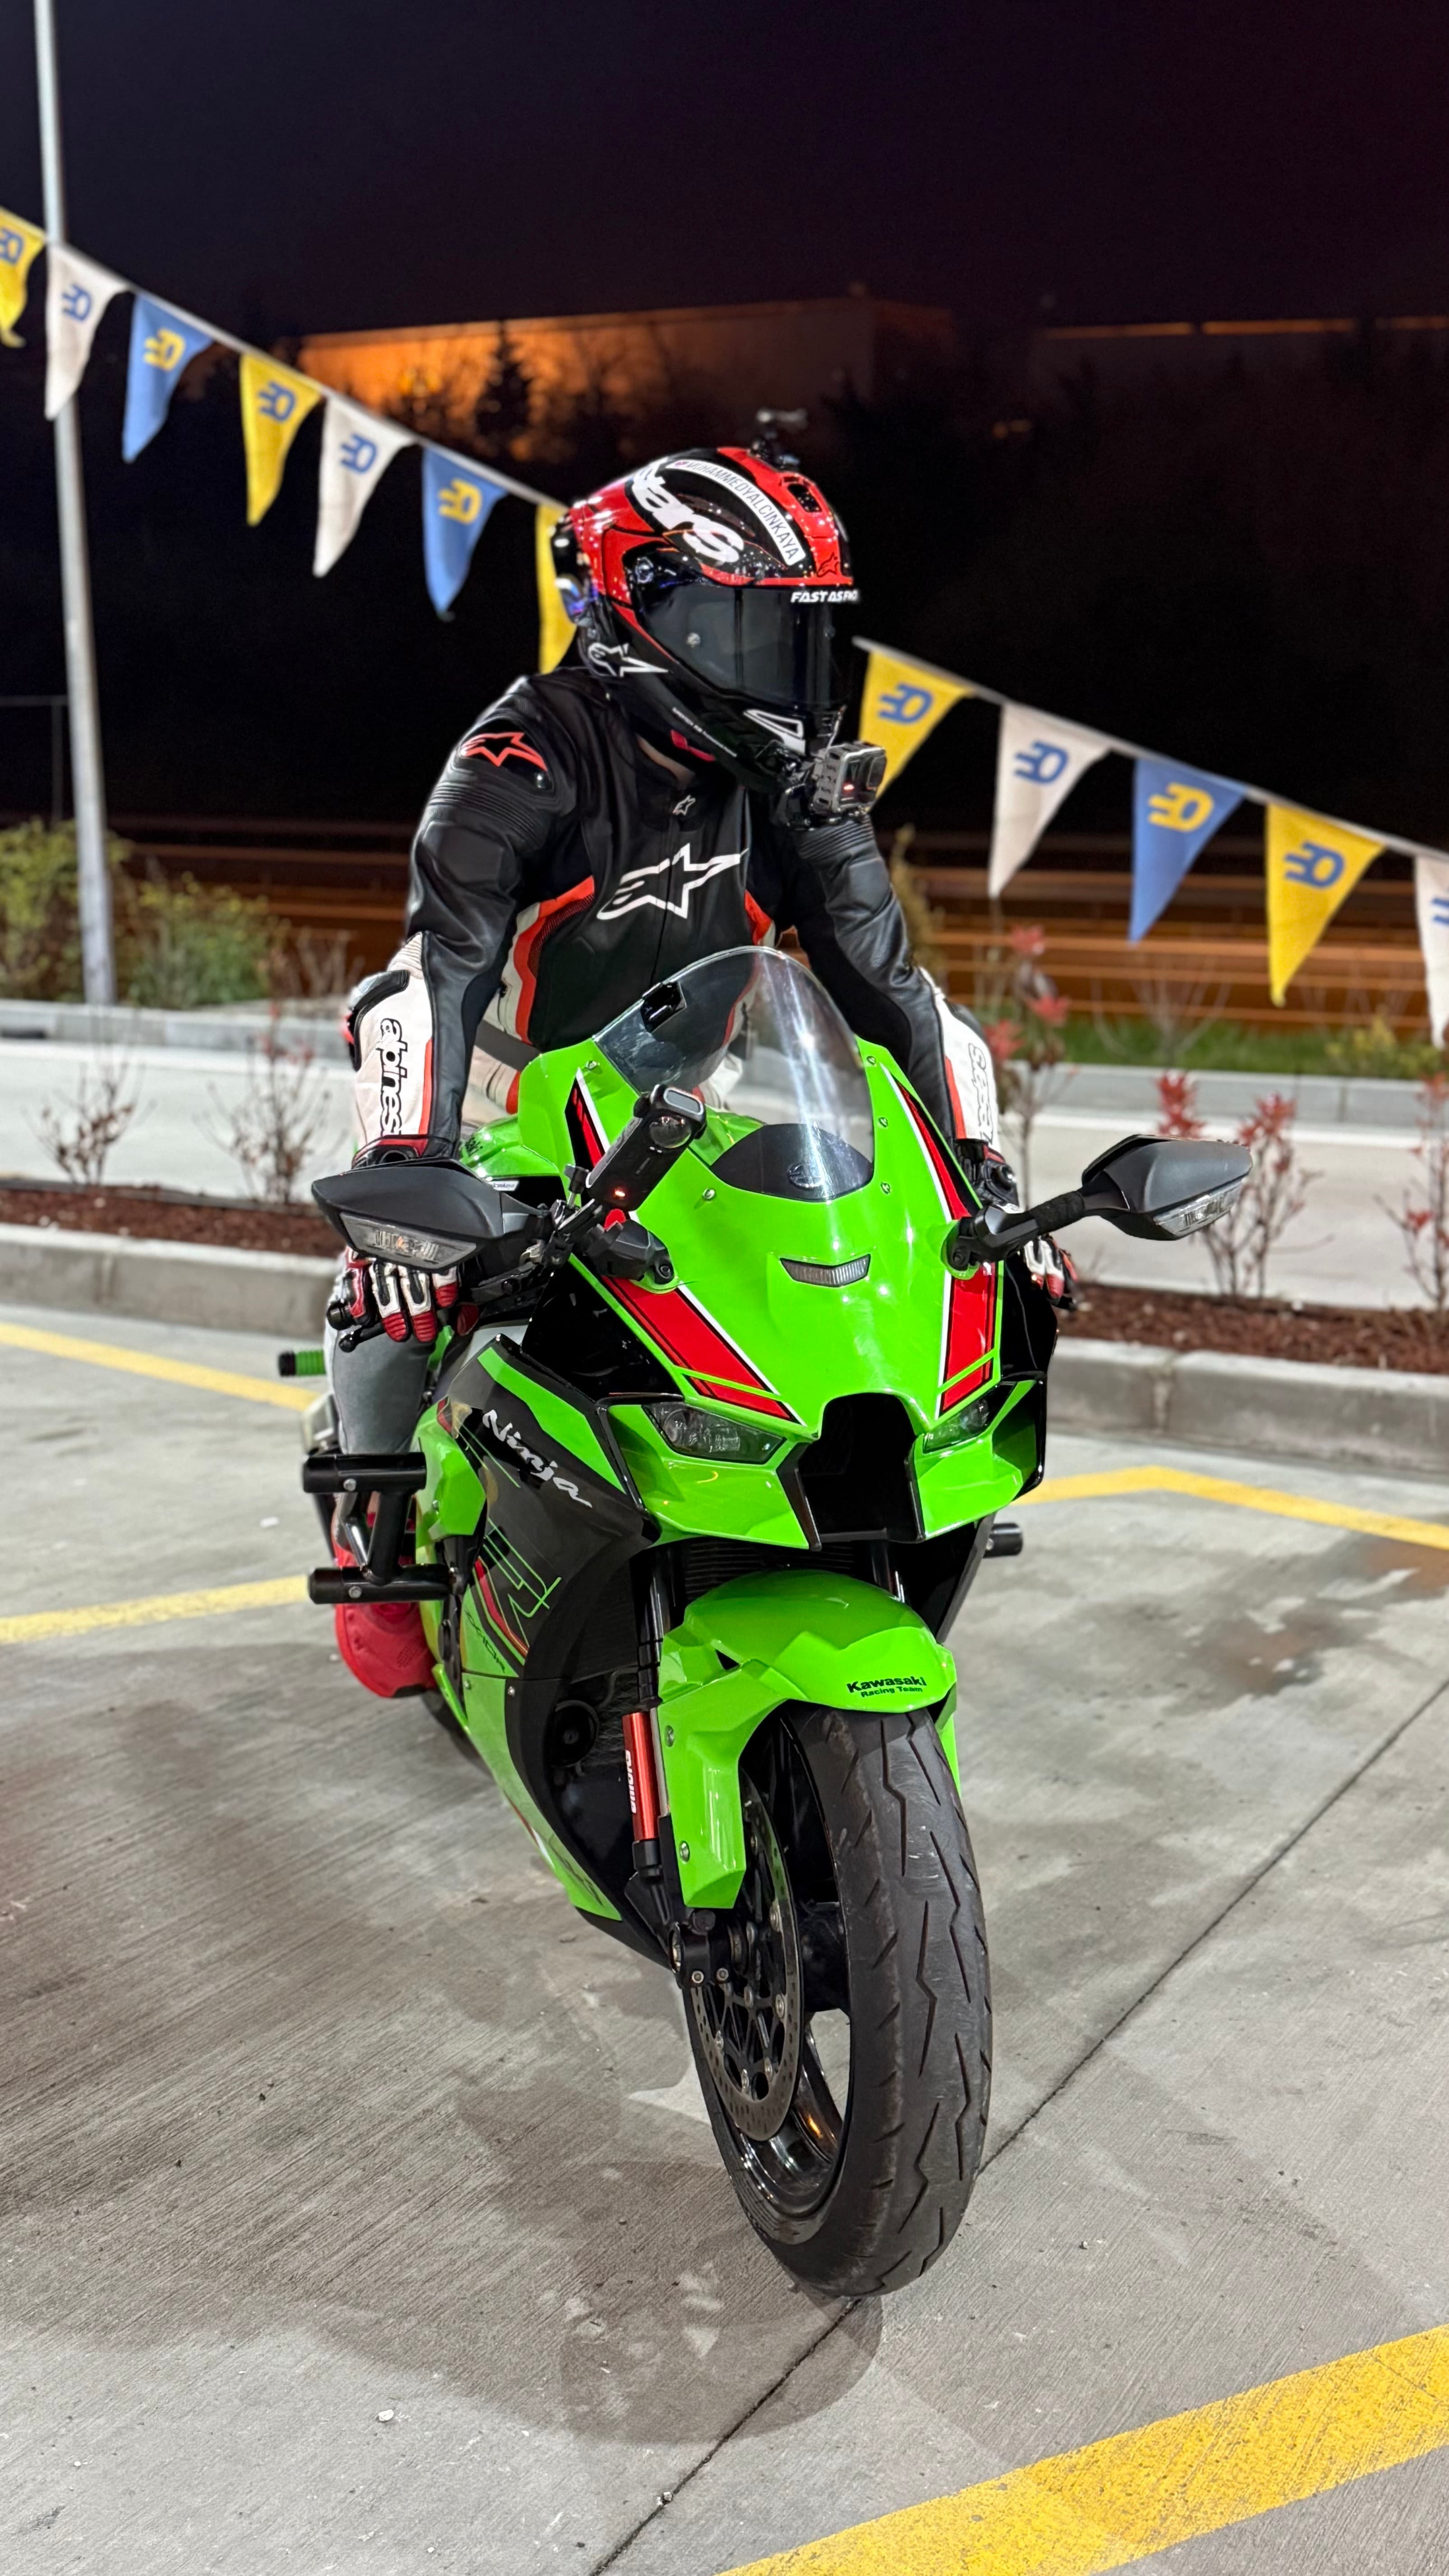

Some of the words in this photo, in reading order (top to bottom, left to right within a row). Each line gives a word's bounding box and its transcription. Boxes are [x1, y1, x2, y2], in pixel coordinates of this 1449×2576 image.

[791, 591, 828, 603] FAST
[375, 1017, 408, 1136] alpines
[482, 1409, 593, 1508] Ninja
[846, 1676, 927, 1693] Kawasaki
[861, 1688, 895, 1697] Racing
